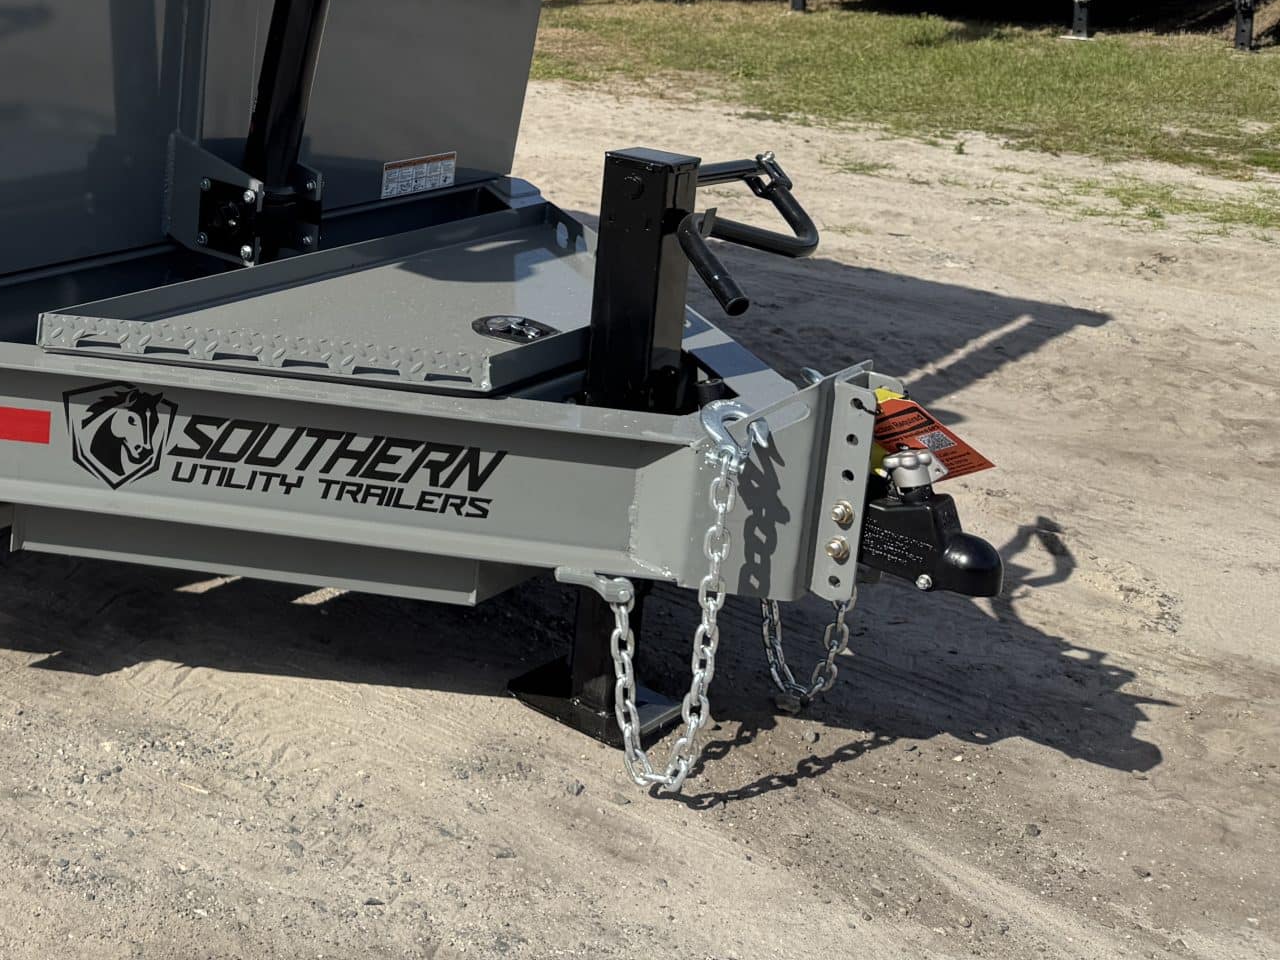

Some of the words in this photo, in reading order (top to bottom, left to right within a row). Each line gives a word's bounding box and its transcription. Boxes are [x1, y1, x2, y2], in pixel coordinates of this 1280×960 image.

[167, 414, 508, 493] SOUTHERN
[171, 461, 304, 495] UTILITY
[318, 478, 493, 519] TRAILERS
